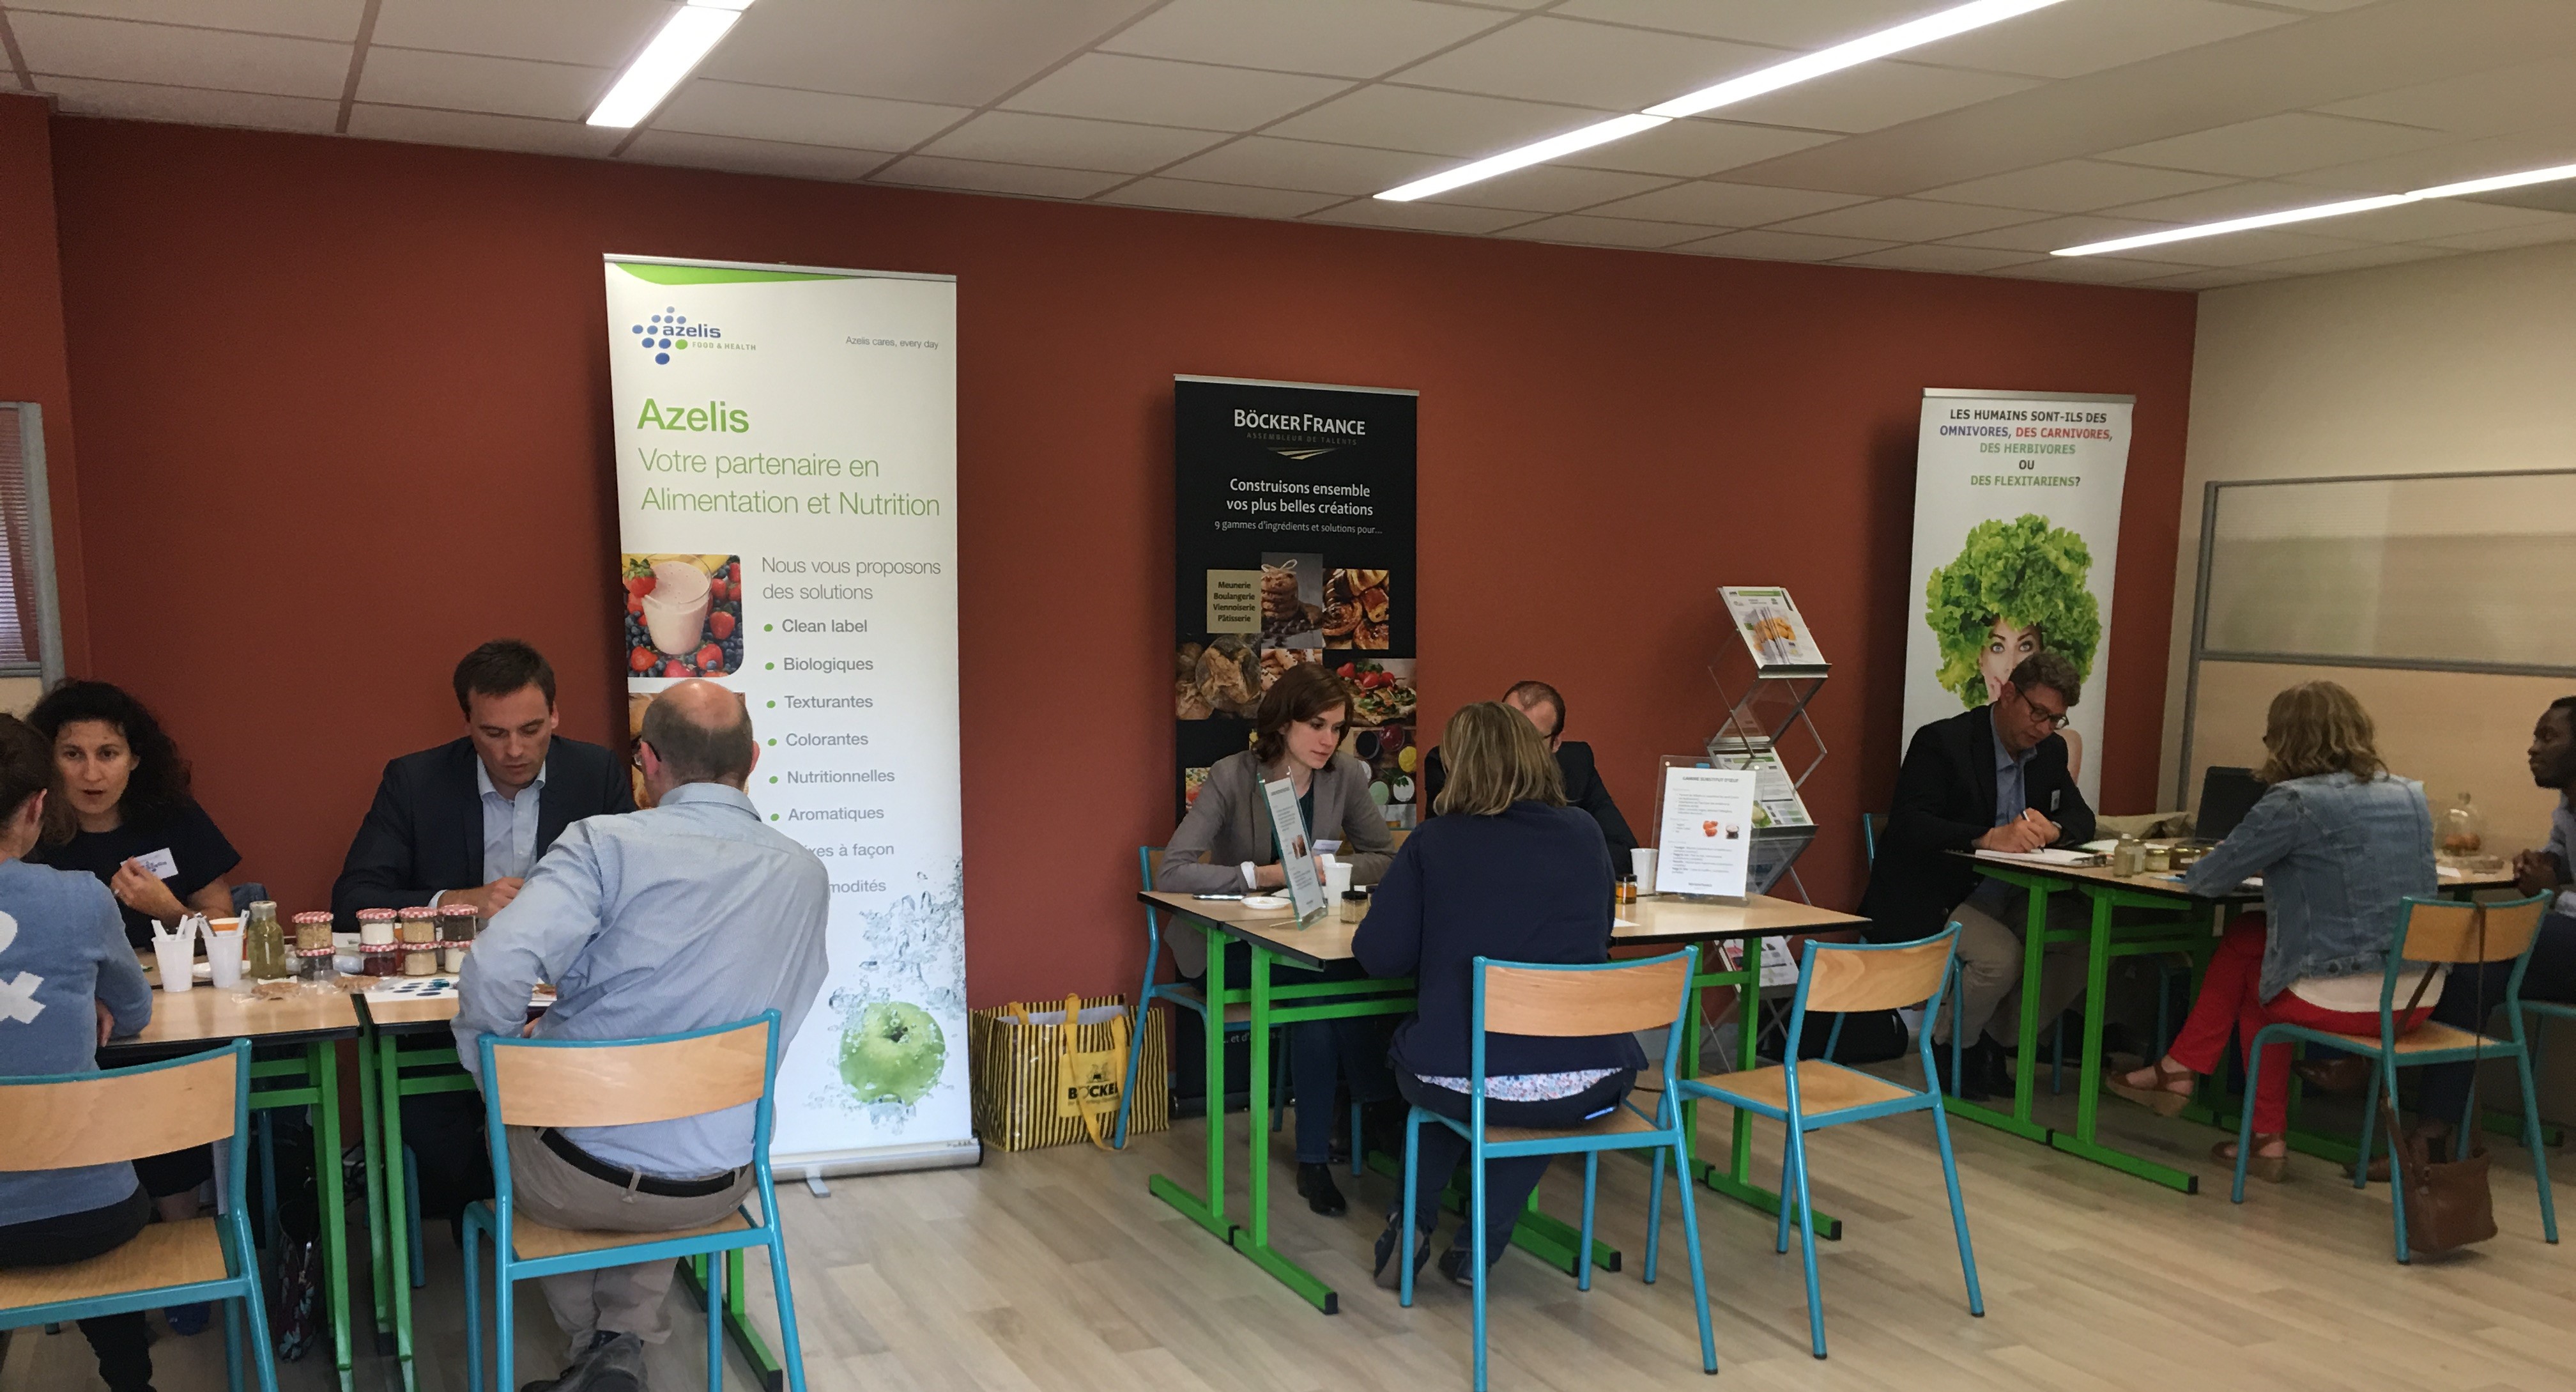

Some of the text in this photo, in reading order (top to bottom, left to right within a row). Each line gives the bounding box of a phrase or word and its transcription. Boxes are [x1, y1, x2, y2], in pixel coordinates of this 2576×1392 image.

[662, 323, 721, 339] azelis
[846, 336, 939, 350] Azelis cares, every day
[637, 399, 749, 433] Azelis
[1951, 409, 2106, 423] LES HUMAINS SONT-ILS DES
[1304, 414, 1365, 435] FRANCE
[1246, 432, 1303, 442] ASSEMBLEUR
[1321, 437, 1357, 445] TALENTS
[1940, 426, 2113, 442] OMNIVORES, DES CARNIVORES,
[1980, 443, 2076, 454] DES HERBIVORES
[638, 447, 878, 478] Votre partenaire en
[2019, 460, 2034, 470] OU
[1230, 479, 1370, 497] Construisons ensemble
[1971, 476, 2081, 487] DES FLEXITARIENS?
[641, 487, 939, 516] Alimentation et Nutrition
[1227, 498, 1372, 515] vos plus belles créations
[1222, 522, 1256, 531] gammes
[1258, 521, 1309, 532] d'ingrédients
[1321, 523, 1355, 532] solutions
[762, 557, 941, 577] Nous vous proposons
[763, 584, 873, 599] des solutions
[1213, 592, 1255, 602] Boulangerie
[1213, 603, 1256, 611] Viennoiserie
[782, 619, 867, 632] Clean label
[784, 658, 873, 674] Biologiques
[785, 695, 873, 708] Texturantes
[786, 733, 868, 746] Colorantes
[788, 769, 894, 784] Nutritionnelles
[788, 807, 884, 822] Aromatiques
[839, 844, 848, 856] à
[852, 844, 894, 859] façon
[829, 879, 886, 893] modités
[1068, 1082, 1118, 1099] BCKE
